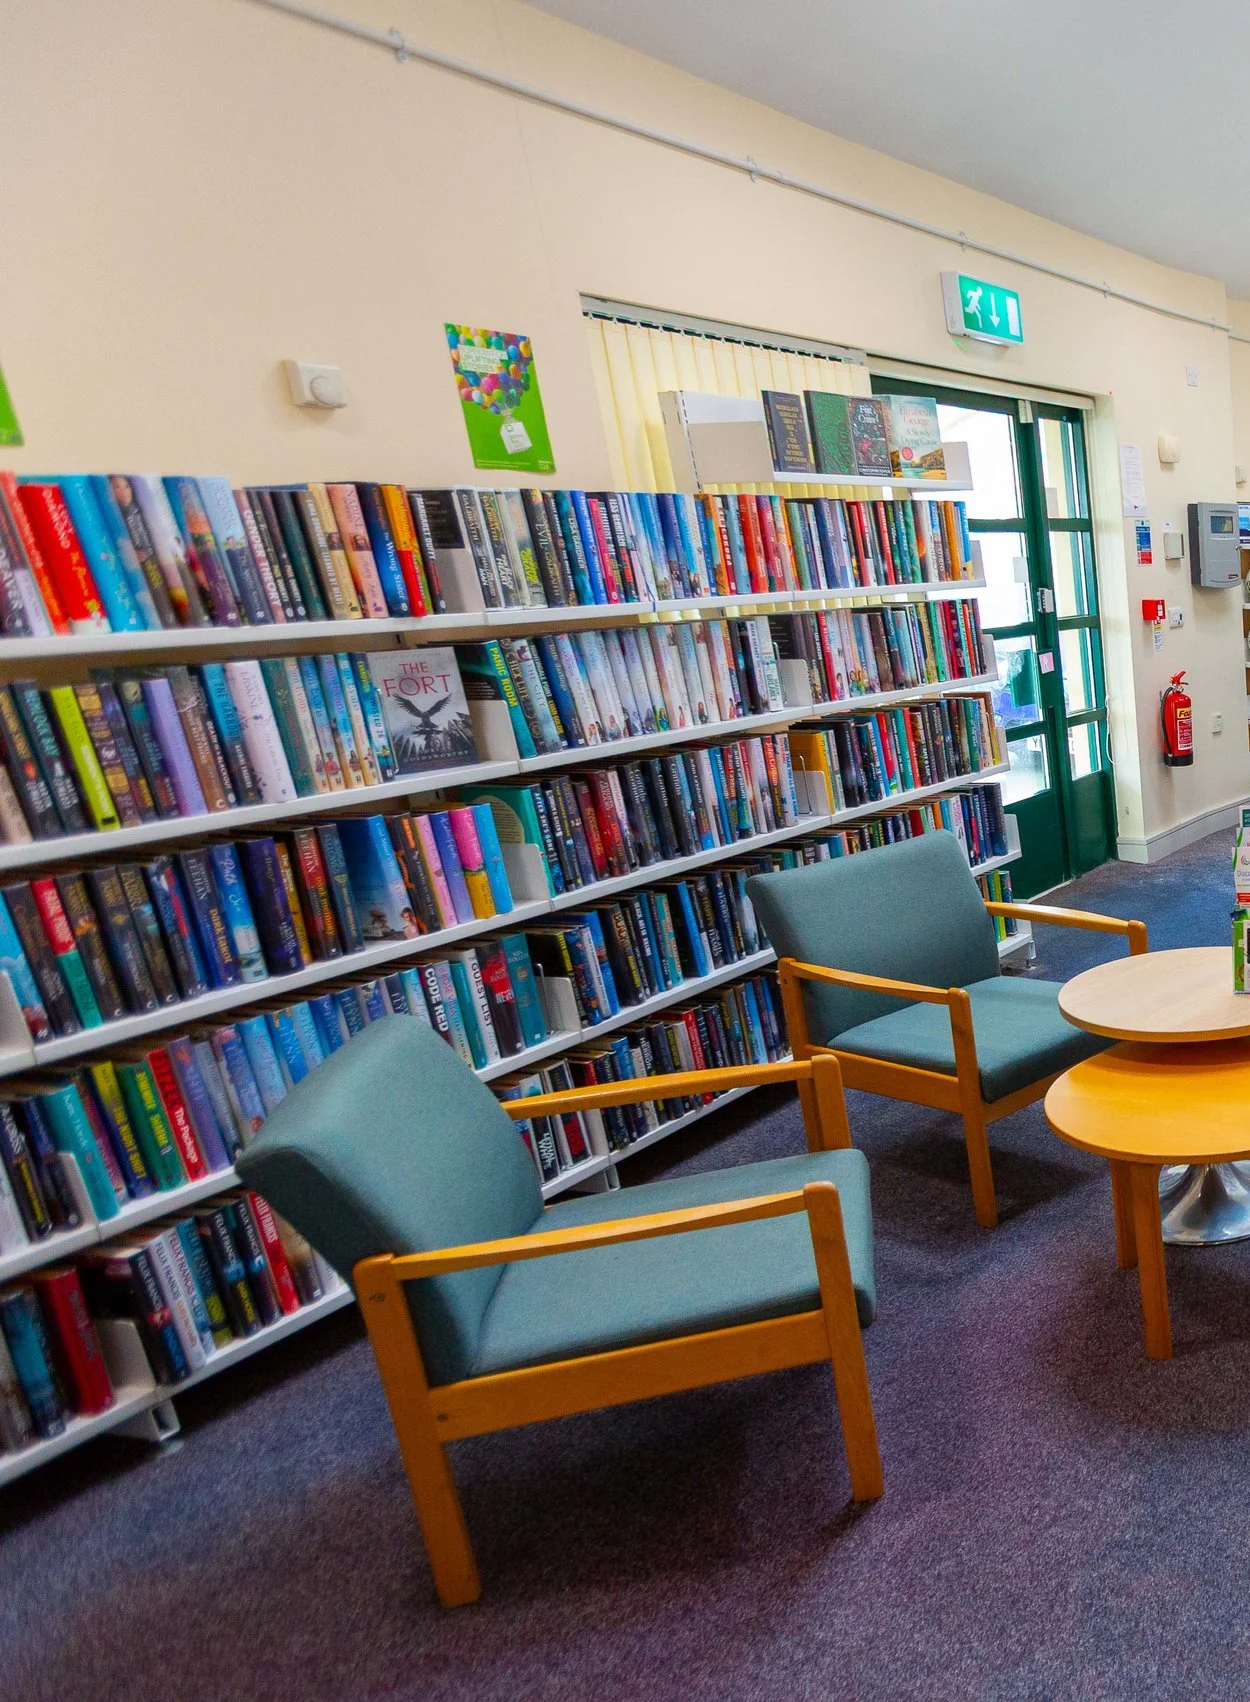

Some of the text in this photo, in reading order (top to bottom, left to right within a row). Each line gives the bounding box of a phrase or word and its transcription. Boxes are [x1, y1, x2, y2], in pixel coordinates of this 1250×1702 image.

[900, 406, 930, 417] Elizabeth
[904, 415, 929, 427] George
[901, 437, 938, 446] Dying Cause
[912, 429, 931, 438] Slowly
[462, 494, 480, 541] GALBRAITH
[482, 495, 499, 542] GALBRAITH
[579, 496, 588, 515] Hope
[416, 494, 437, 561] MARGARET DUFFY
[535, 522, 549, 551] EVIL
[568, 517, 585, 569] LISA GARDNER
[615, 514, 627, 548] GERRITSEN
[243, 508, 282, 606] GENDER THEORY
[385, 541, 407, 602] Wrong Sister
[496, 557, 509, 586] HEART
[521, 551, 535, 582] GRAVE
[357, 660, 371, 693] EVANOVICH
[383, 674, 451, 698] FORT
[399, 661, 429, 675] THE
[490, 647, 518, 708] PANIC ROOM
[509, 660, 528, 702] HEX LIFE
[526, 663, 546, 708] THE CITY
[555, 661, 568, 692] darlings
[241, 671, 257, 711] ERSKINE
[296, 686, 308, 717] Evans
[311, 683, 324, 718] Evans
[332, 683, 343, 714] Evans
[348, 681, 360, 714] Evans
[531, 644, 565, 735] NIGHTINGALE POINT GOLDIE
[220, 700, 239, 741] HARBOUR
[206, 721, 232, 790] DEATH BLACKOUT
[768, 757, 777, 787] Grisham
[657, 773, 668, 807] Griffiths
[670, 763, 681, 796] Griffiths
[694, 775, 703, 804] Grisham
[718, 767, 729, 799] Grisham
[737, 767, 746, 799] Grisham
[534, 792, 558, 861] AFTER SHE'S GONE
[220, 858, 238, 886] Path
[300, 832, 315, 874] FEEHAN
[188, 858, 207, 901] FEEHAN
[424, 967, 449, 1032] CODE RED
[471, 962, 493, 1028] GUEST LIST
[118, 1122, 136, 1152] NIGHT
[129, 1152, 147, 1180] SHIFT
[175, 1108, 199, 1164] The Package
[238, 1203, 261, 1259] FELIX FRANCIS
[254, 1195, 279, 1245] FELIX FRANCIS
[214, 1213, 237, 1269] FELIX FRANCIS
[137, 1256, 162, 1314] FELIX FRANCIS
[155, 1243, 180, 1301] FELIX FRANCIS
[169, 1232, 196, 1302] FELIX FRANCIS
